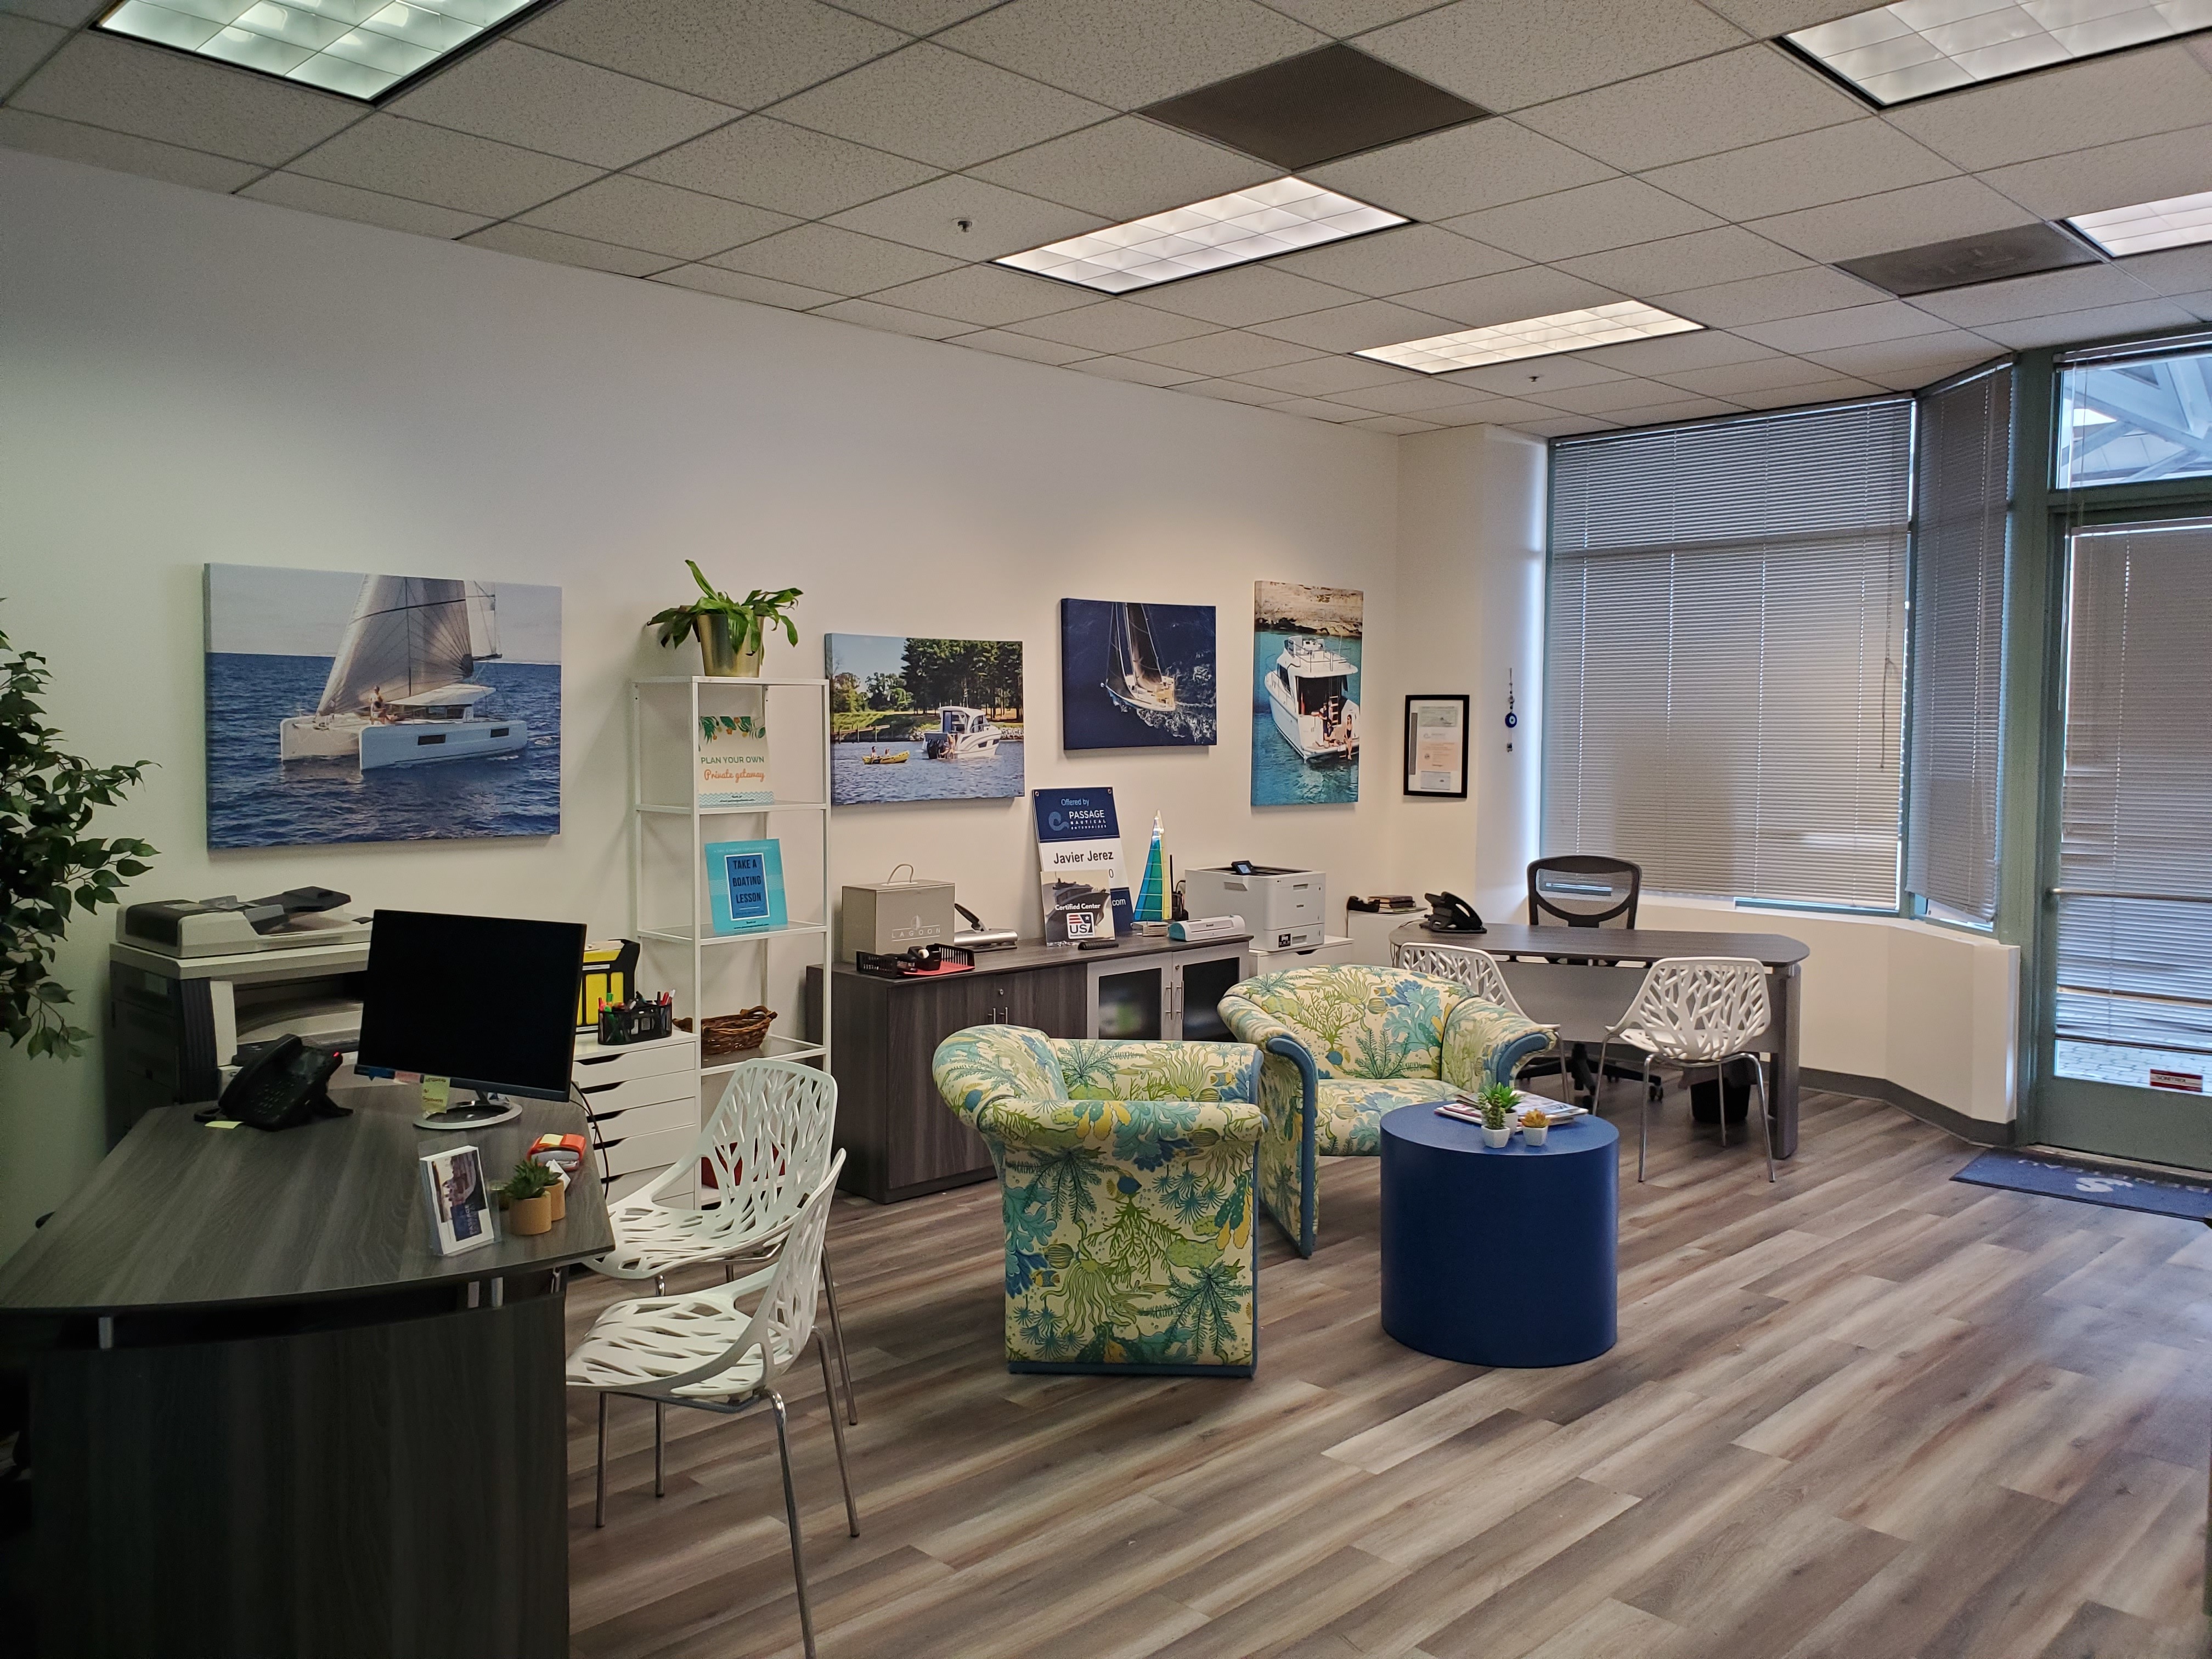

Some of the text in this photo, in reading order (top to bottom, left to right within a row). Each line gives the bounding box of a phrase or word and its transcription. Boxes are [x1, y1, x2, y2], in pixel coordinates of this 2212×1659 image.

[704, 768, 765, 783] Private getaway
[1069, 810, 1105, 819] PASSAGE
[1054, 850, 1114, 864] Javier Jerez
[733, 859, 757, 869] TAKE A
[732, 876, 761, 887] BOATING
[736, 892, 761, 904] LESSON
[891, 927, 940, 938] LAGOON
